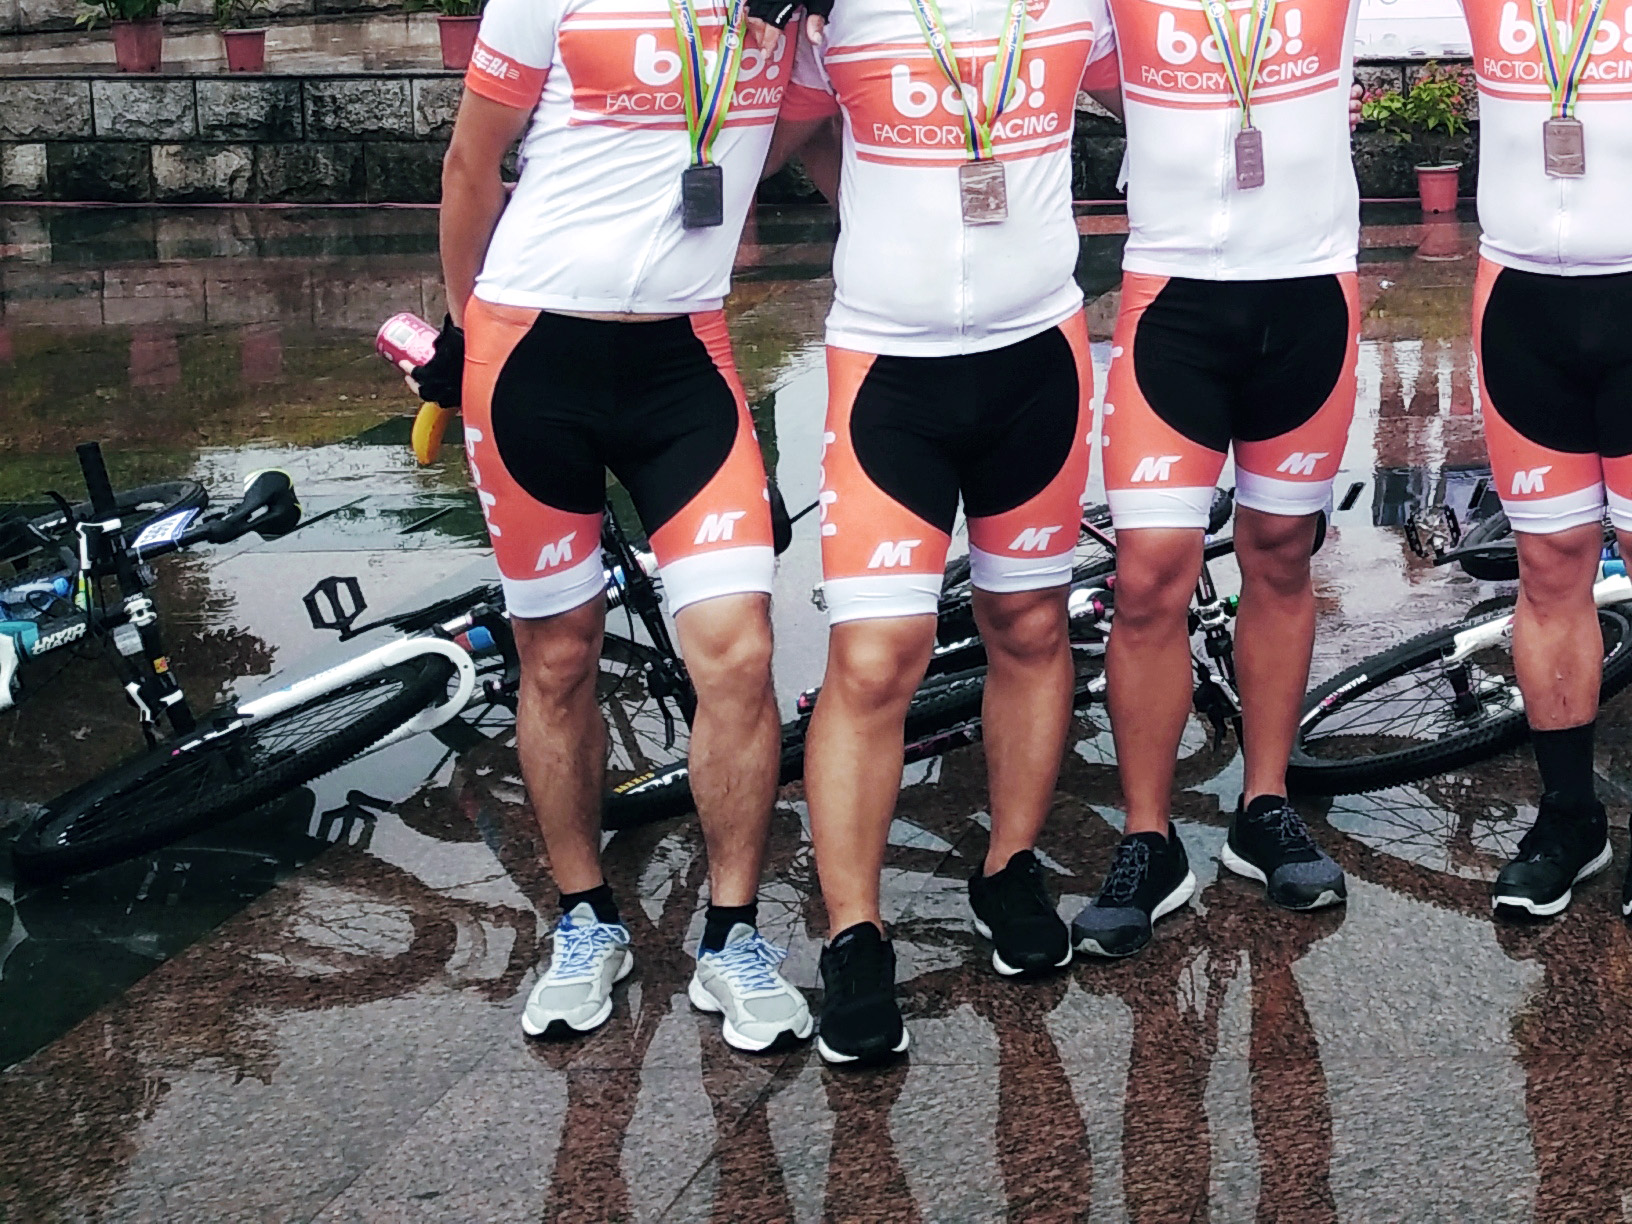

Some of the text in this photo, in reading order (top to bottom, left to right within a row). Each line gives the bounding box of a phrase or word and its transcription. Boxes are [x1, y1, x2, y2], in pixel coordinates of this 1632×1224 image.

[1254, 55, 1320, 84] ACING
[1482, 57, 1543, 80] FACTO
[605, 85, 785, 112] FACTO ACING
[989, 111, 1059, 142] ACING
